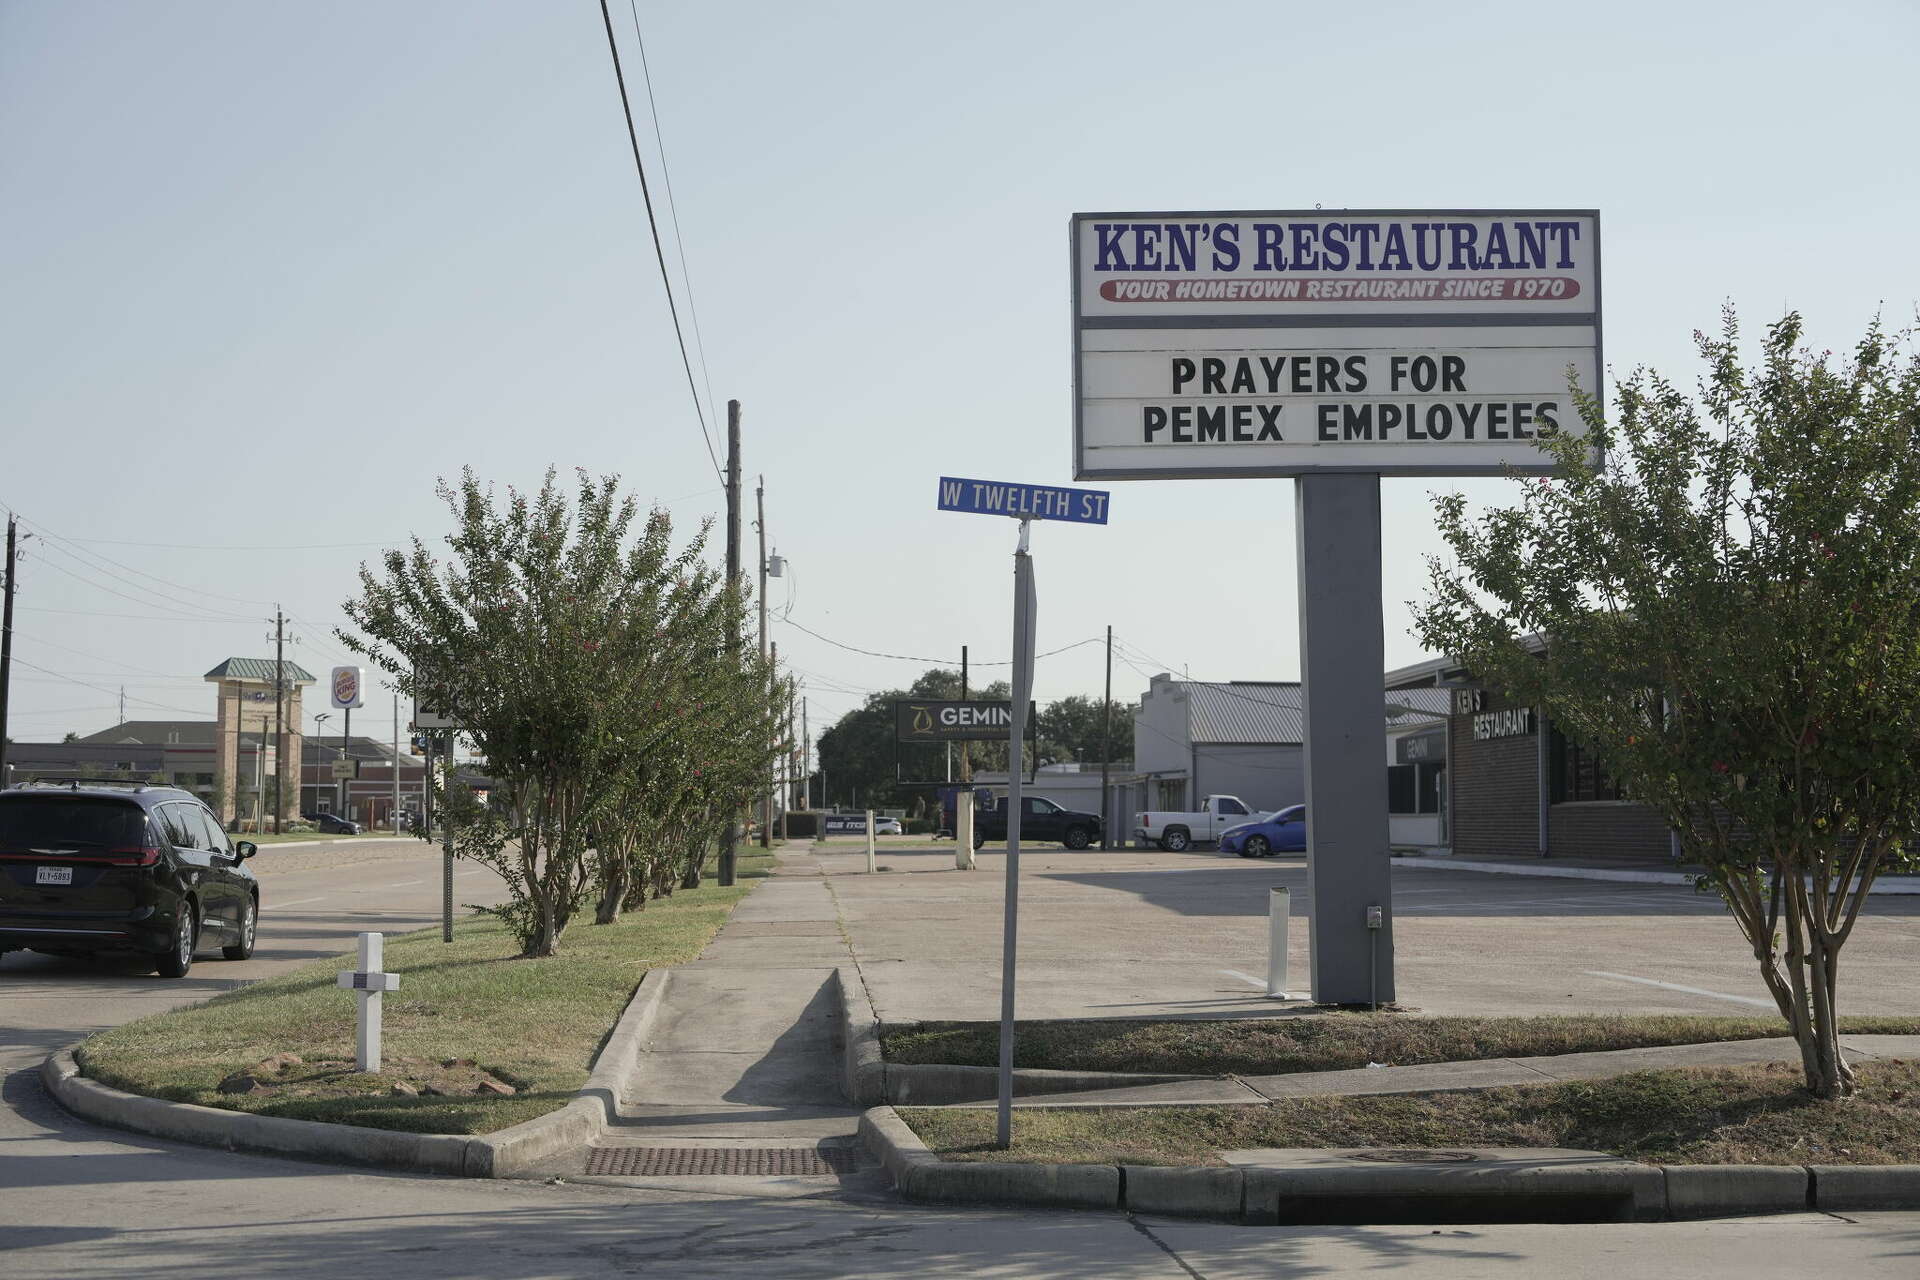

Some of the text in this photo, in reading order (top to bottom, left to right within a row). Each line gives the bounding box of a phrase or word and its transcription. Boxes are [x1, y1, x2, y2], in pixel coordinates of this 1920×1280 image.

[1093, 221, 1581, 273] KEN'S RESTAURANT
[1114, 279, 1566, 300] YOUR HOMETOWN RESTAURANT SINCE 1970
[1172, 355, 1468, 394] PRAYERS FOR
[1143, 402, 1560, 443] PEMEX EMPLOYEES
[942, 481, 1106, 520] W TWELFTH ST
[336, 681, 357, 695] KING
[1456, 688, 1481, 714] KEN'S
[940, 706, 1012, 726] GEMIN
[1473, 707, 1530, 741] RESTAURANT
